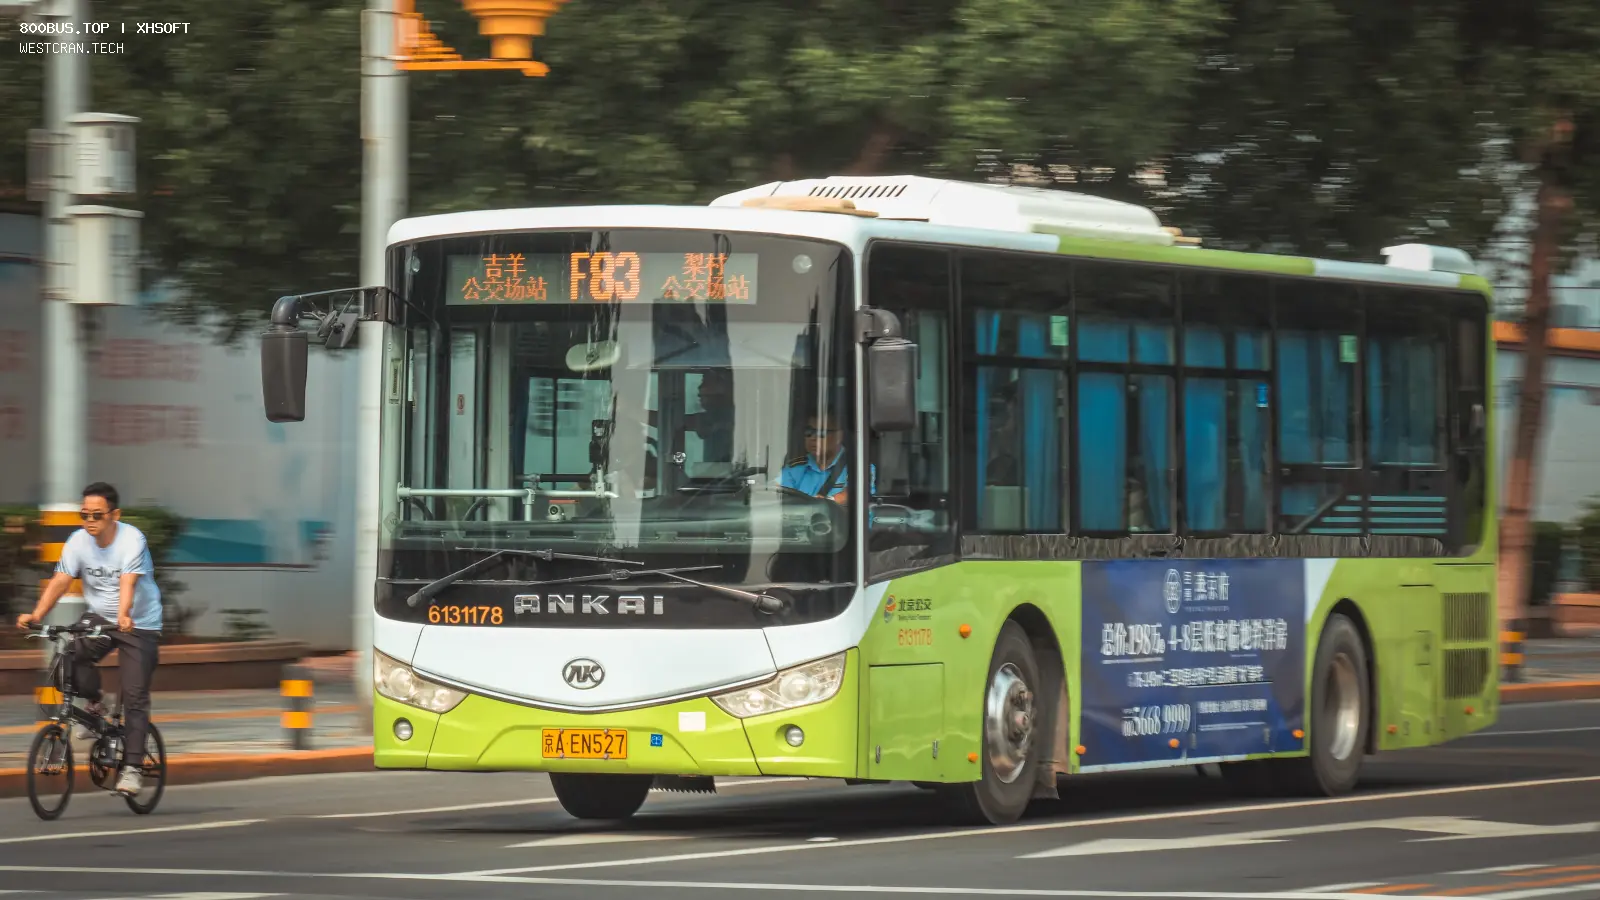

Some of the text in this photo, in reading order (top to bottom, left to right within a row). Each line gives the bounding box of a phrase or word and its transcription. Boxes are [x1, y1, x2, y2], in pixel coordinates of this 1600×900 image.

[482, 252, 527, 278] 吉羊
[570, 251, 641, 301] F83
[683, 252, 728, 276] 梨村
[460, 276, 548, 301] 公交场站
[660, 274, 750, 301] 公交场站
[428, 605, 504, 625] 6131178
[513, 593, 664, 615] ANKAI
[898, 598, 933, 612] 北京公交
[898, 628, 933, 647] 6131178
